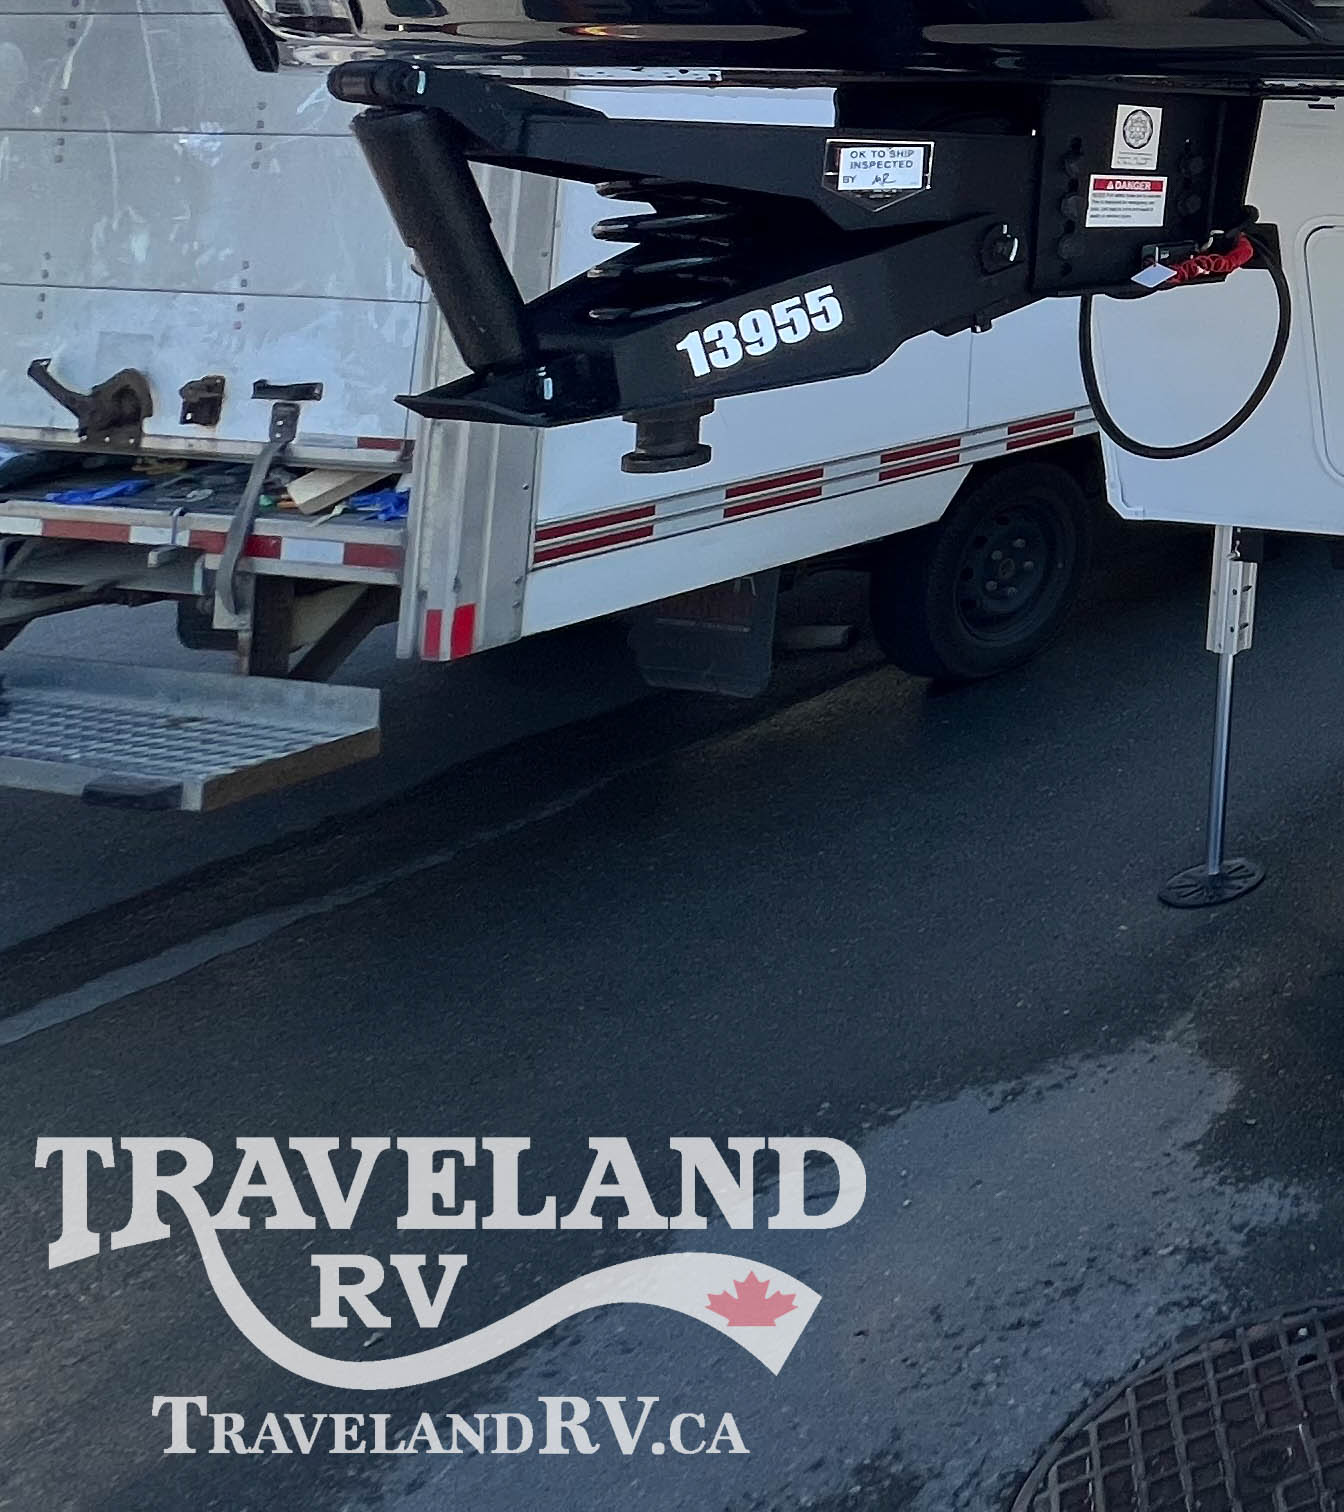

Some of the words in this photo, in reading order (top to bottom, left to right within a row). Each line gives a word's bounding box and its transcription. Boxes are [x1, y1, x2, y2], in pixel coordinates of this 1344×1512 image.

[850, 150, 866, 159] OK
[872, 150, 886, 159] TO
[889, 149, 915, 158] SHIP
[849, 160, 914, 170] INSPECTED
[842, 175, 857, 184] BY
[1115, 180, 1152, 191] DANGER
[674, 284, 844, 378] 13955
